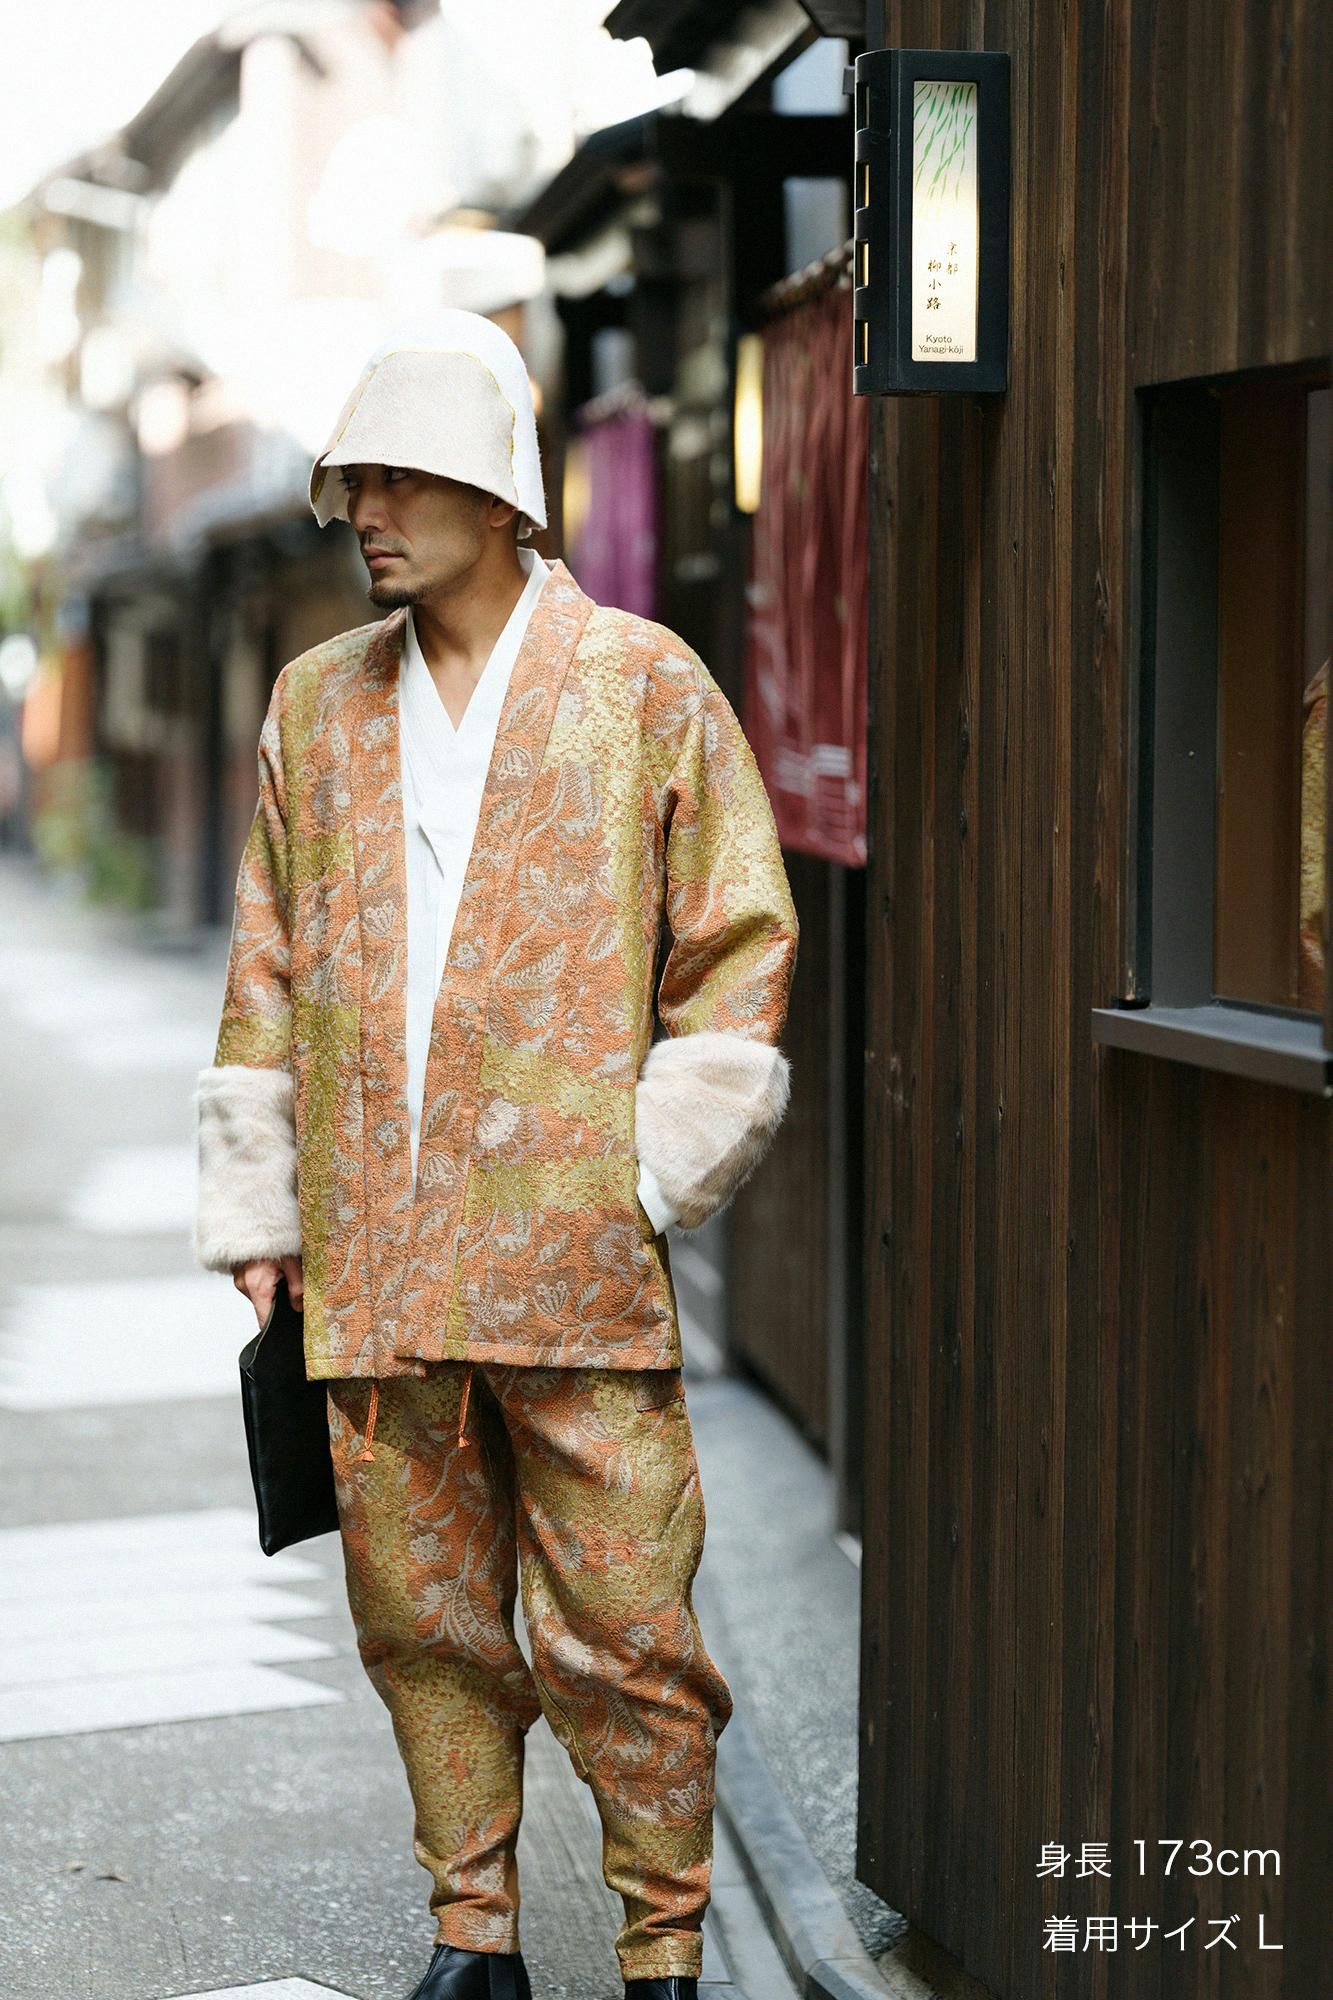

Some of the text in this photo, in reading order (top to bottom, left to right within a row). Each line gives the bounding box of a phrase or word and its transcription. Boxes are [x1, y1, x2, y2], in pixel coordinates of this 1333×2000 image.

[926, 259, 942, 310] 柳小路
[925, 334, 953, 344] Kyoto
